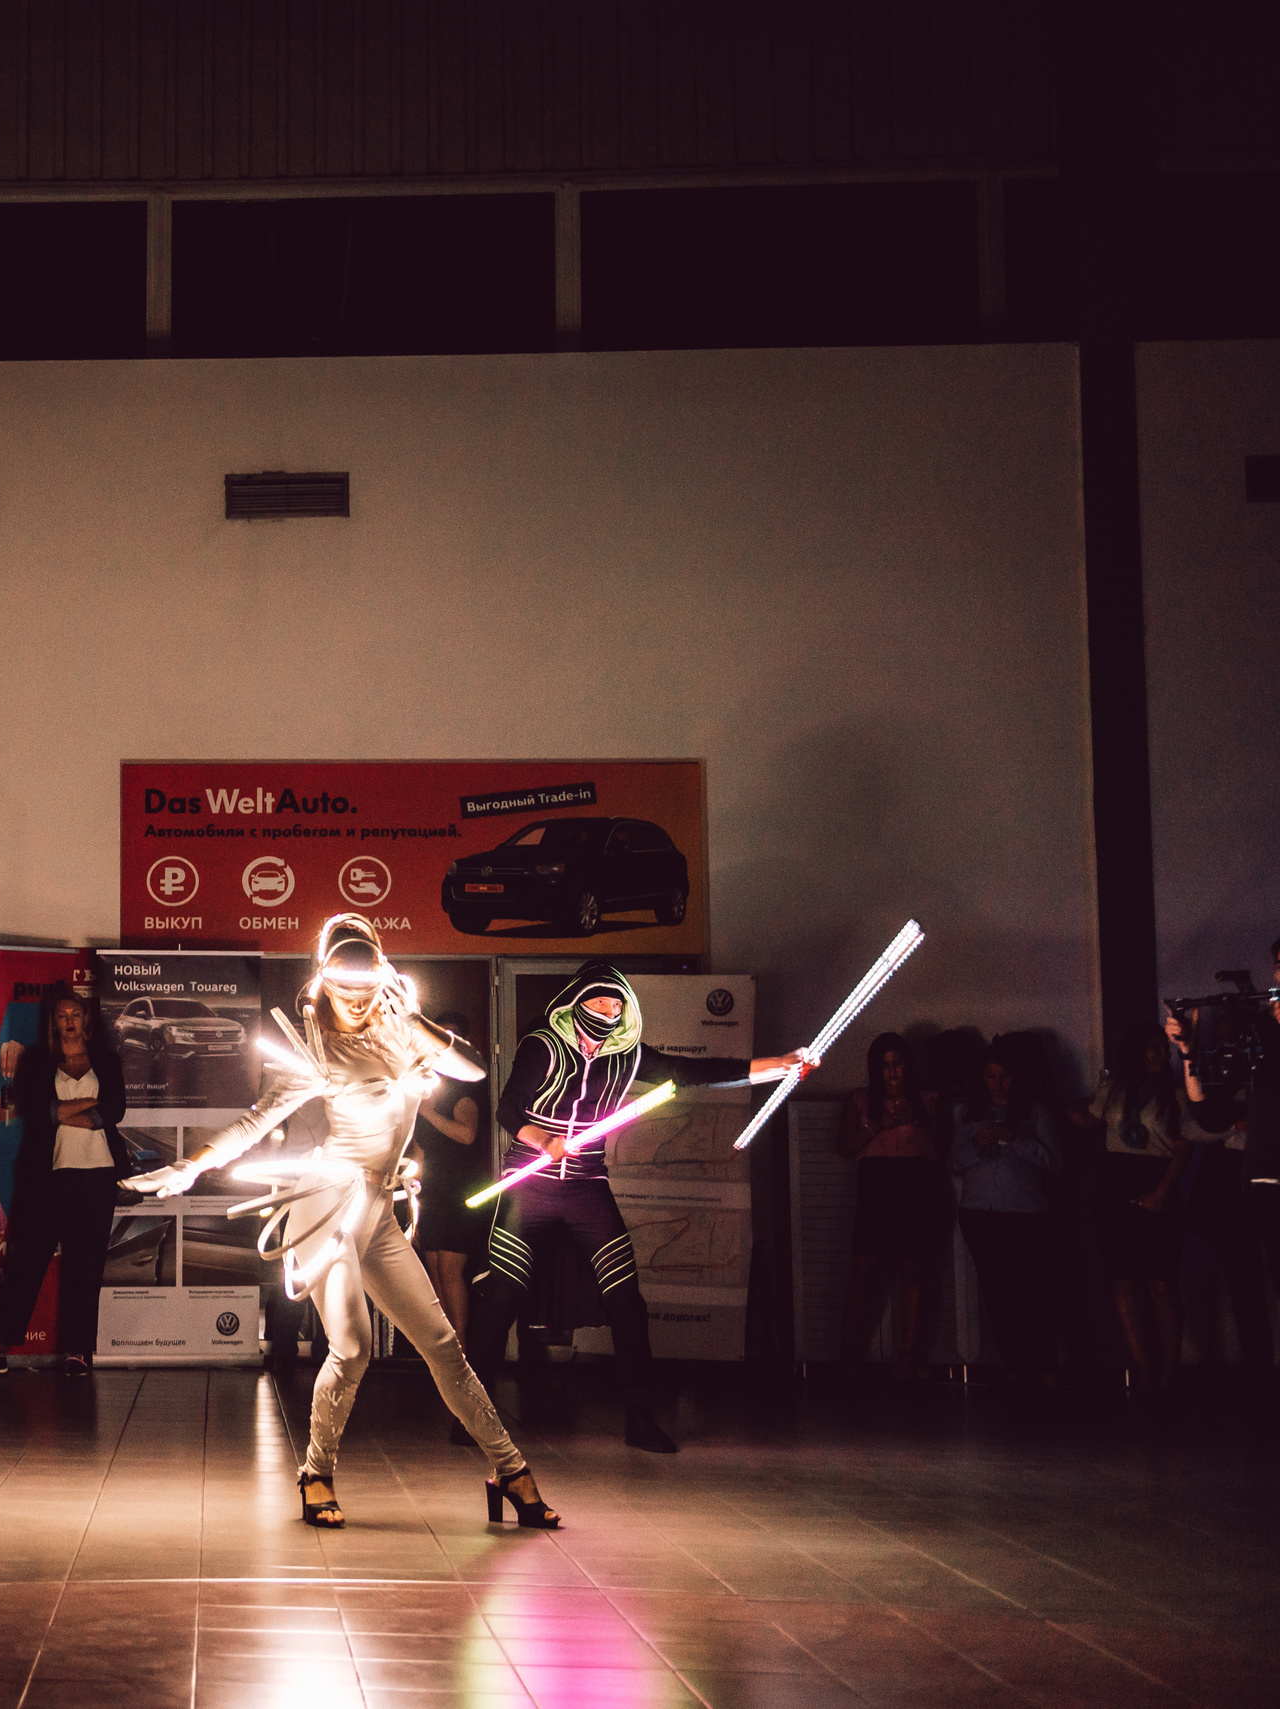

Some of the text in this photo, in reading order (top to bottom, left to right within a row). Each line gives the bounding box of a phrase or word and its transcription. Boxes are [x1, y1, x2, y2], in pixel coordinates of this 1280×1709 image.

[145, 788, 201, 815] Das
[466, 787, 592, 813] Выгодный Trade-in
[144, 824, 462, 841] Автомобили с пробегом и репутацией.
[144, 917, 203, 930] ВЫКУП
[239, 917, 299, 930] ОБМЕН
[114, 963, 161, 976] НОВЫЙ
[114, 981, 237, 994] Volkswagen Touareg
[667, 1045, 707, 1053] маршрут
[663, 1313, 711, 1322] дорогах!
[111, 1338, 187, 1348] Воплощаем будущее
[212, 1339, 244, 1347] Volkswagen
